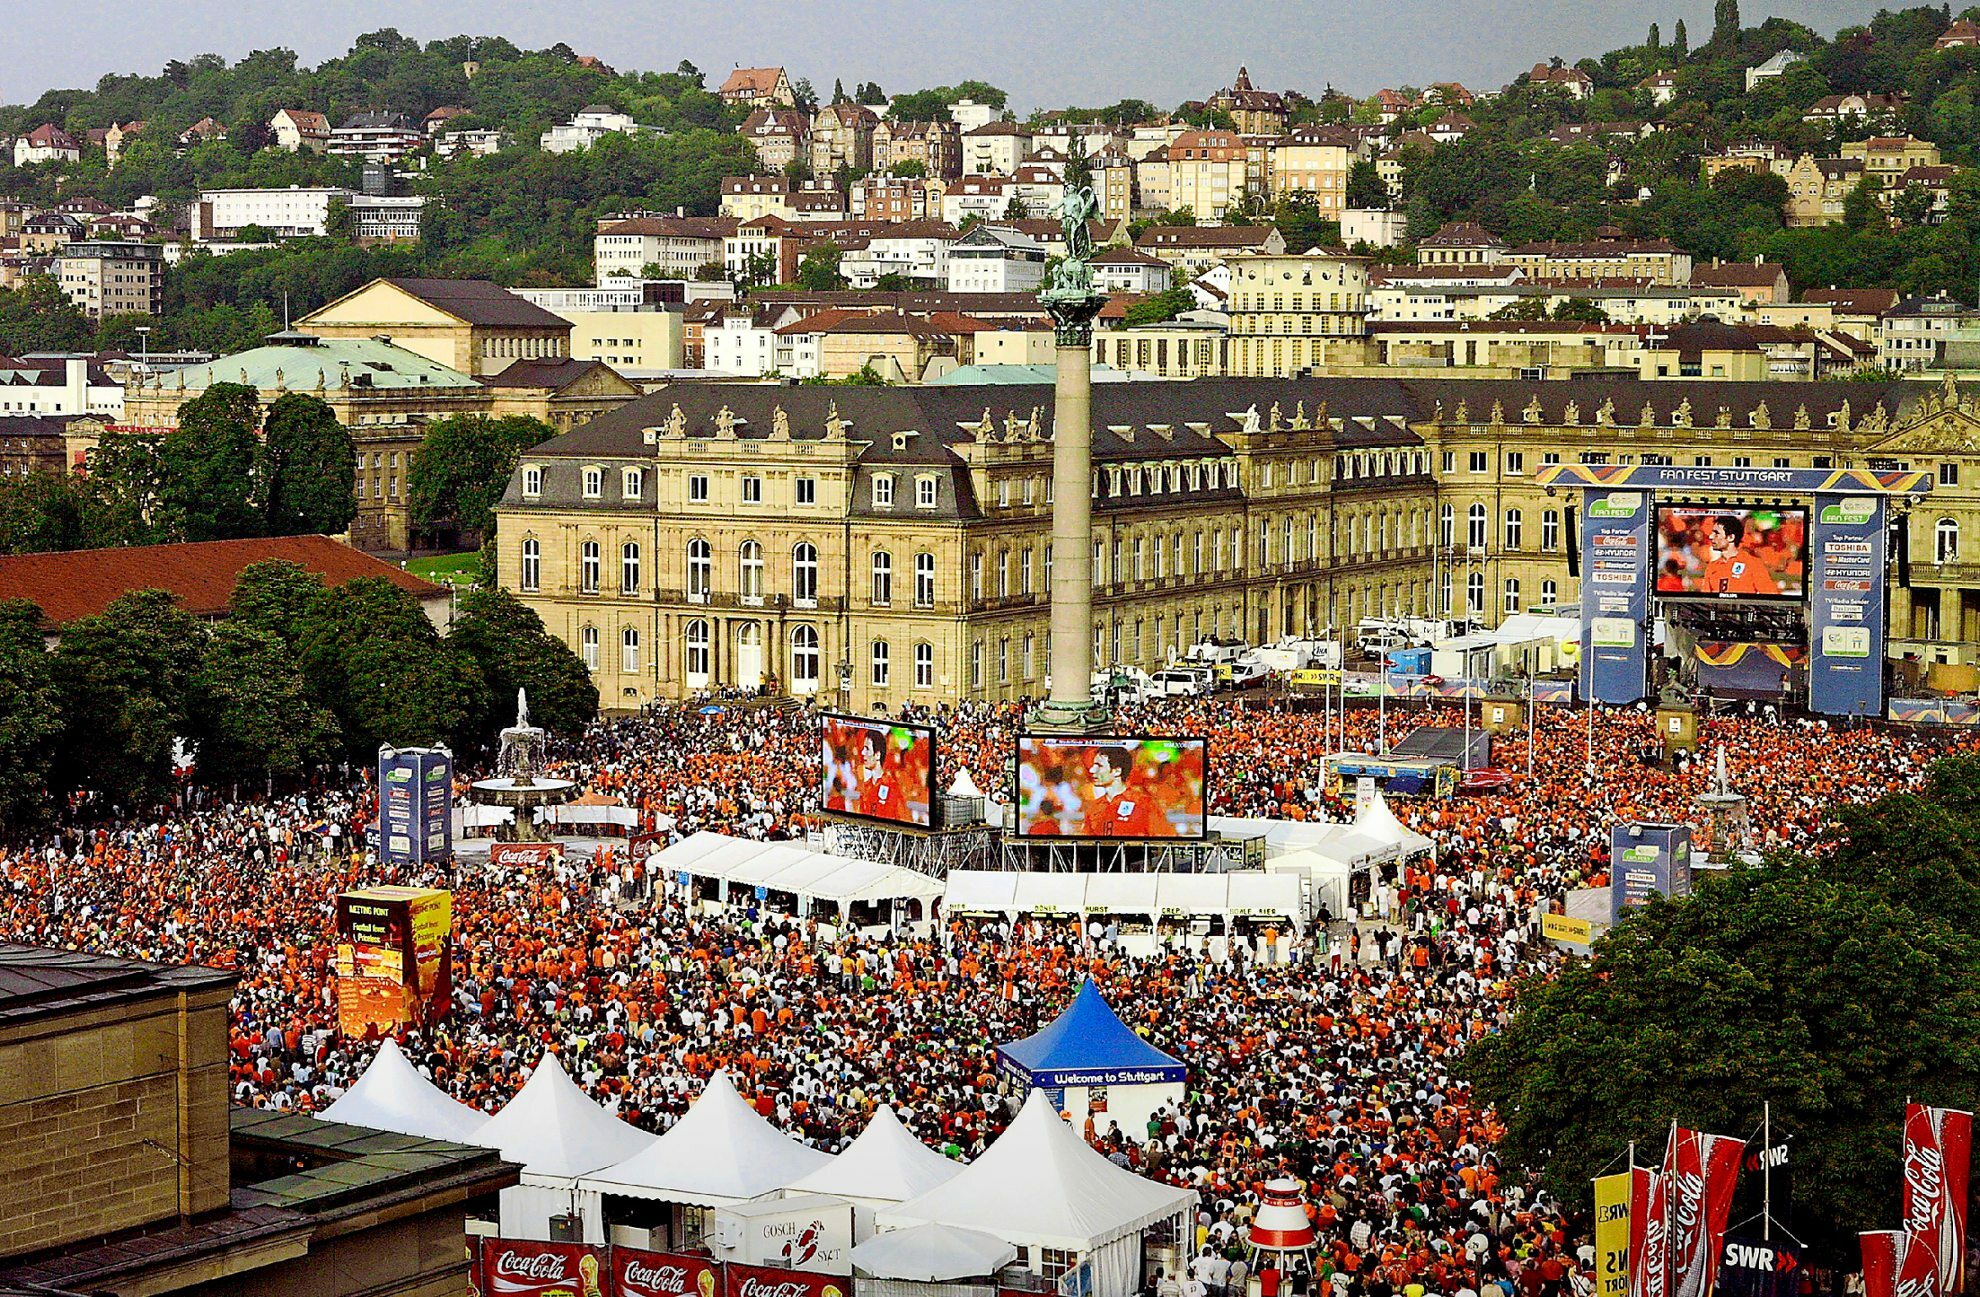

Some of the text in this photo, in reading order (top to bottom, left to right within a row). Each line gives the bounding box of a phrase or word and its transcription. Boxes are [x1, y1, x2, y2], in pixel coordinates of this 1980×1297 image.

[1660, 469, 1794, 482] FAN FEST STUTTGART
[1829, 543, 1868, 552] TOSHIBA
[1596, 573, 1634, 581] TOSHIBA
[1836, 569, 1870, 577] HYUNDAI
[349, 905, 390, 917] MEETING POINT
[1054, 1071, 1165, 1085] Welcome to Stuttgart
[1903, 1137, 1941, 1238] Coca-Cola
[762, 1221, 796, 1239] GOSCH
[1725, 1242, 1774, 1272] SWR
[497, 1249, 568, 1280] Coca-Cola
[624, 1260, 688, 1293] Coca-Cola
